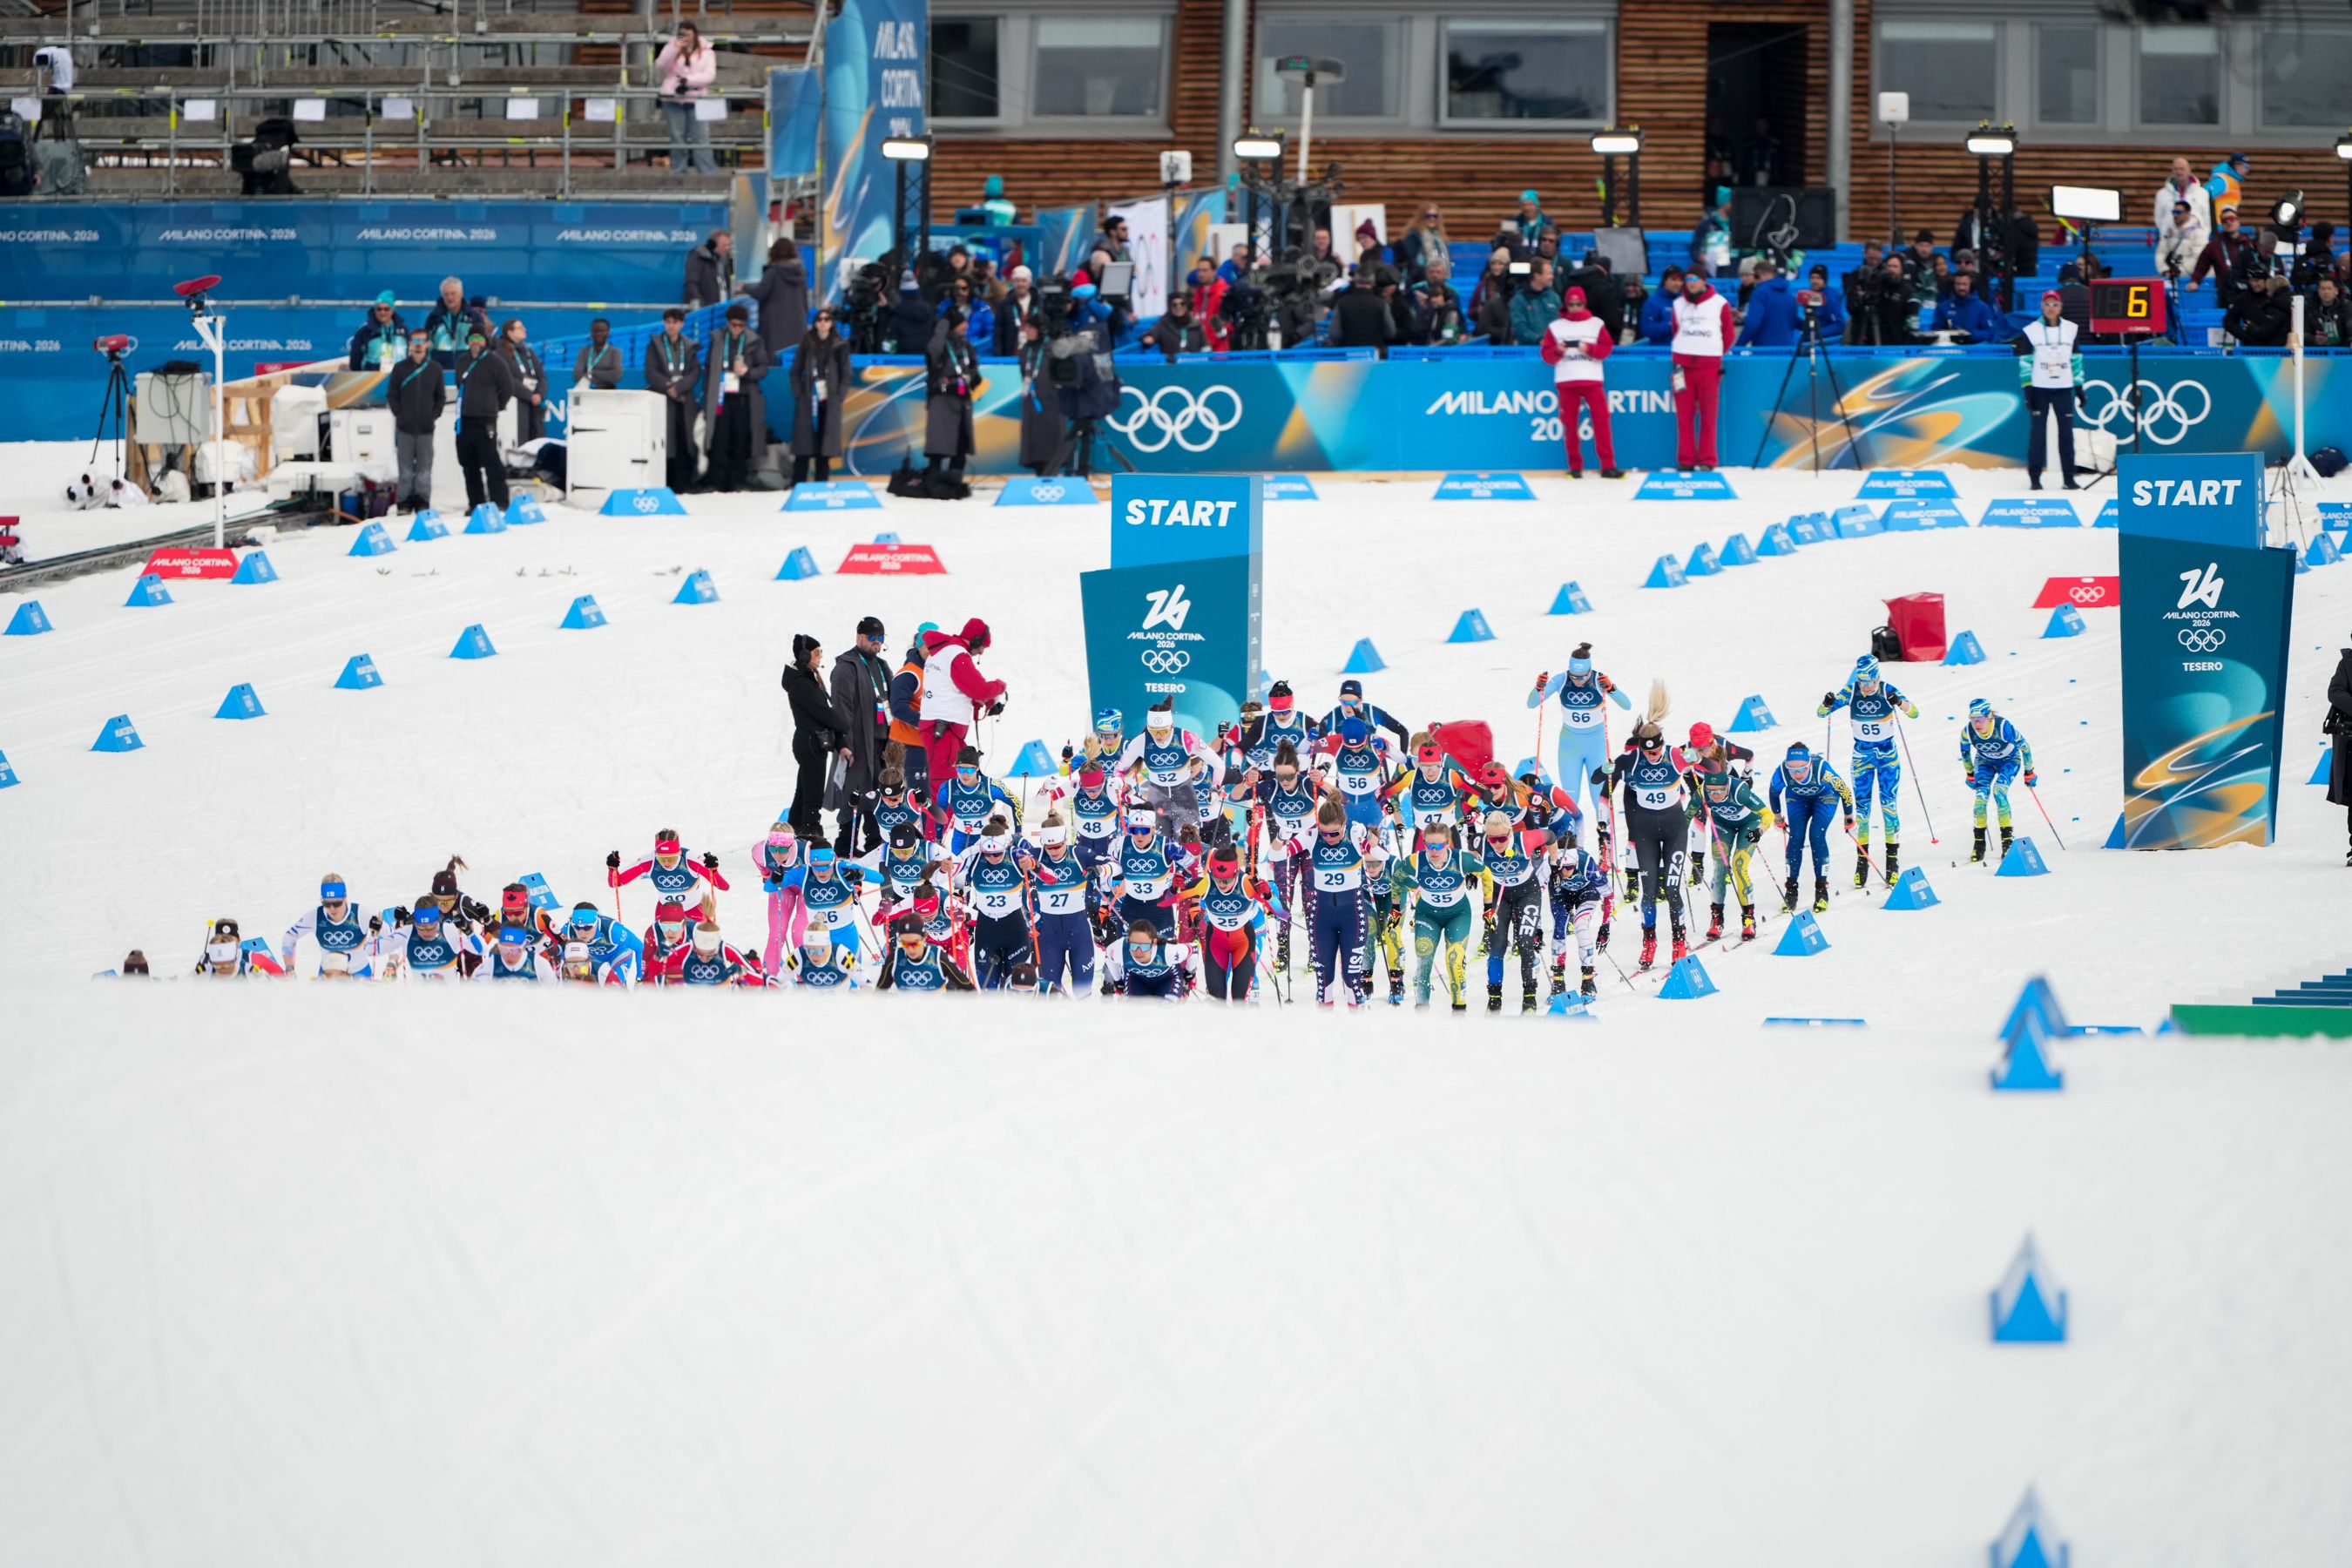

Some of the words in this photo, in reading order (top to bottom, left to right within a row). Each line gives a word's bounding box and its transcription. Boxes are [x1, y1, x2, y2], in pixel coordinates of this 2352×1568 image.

[17, 230, 71, 242] CORTINA
[73, 230, 99, 241] 2026
[159, 229, 213, 241] MILANO
[213, 228, 269, 240] CORTINA
[270, 228, 297, 240] 2026
[356, 228, 411, 240] MILANO
[411, 228, 468, 240] CORTINA
[469, 228, 497, 240] 2026
[557, 229, 612, 241] MILANO
[612, 229, 669, 242] CORTINA
[670, 230, 698, 242] 2026
[2127, 287, 2148, 317] 6
[34, 340, 61, 351] 2026
[227, 339, 284, 351] CORTINA
[286, 339, 313, 351] 2026
[1426, 390, 1558, 415] MILANO
[1531, 417, 1595, 441] 206
[2132, 479, 2242, 506] START
[1125, 499, 1237, 527] START
[152, 558, 193, 567] MILANO
[192, 558, 233, 567] CORTINA
[181, 566, 201, 575] 2026
[1126, 632, 1165, 641] MILANO
[1166, 632, 1206, 641] CORTINA
[1156, 640, 1175, 649] 2026
[2182, 662, 2223, 672] TESERO
[1145, 682, 1186, 693] TESERO
[1571, 712, 1591, 723] 66
[1862, 724, 1881, 736] 65
[1157, 772, 1177, 782] 52
[1348, 777, 1368, 789] 56
[1645, 793, 1666, 804] 49
[963, 820, 983, 829] 54
[1286, 819, 1302, 829] 51
[1424, 814, 1443, 823] 47
[1083, 821, 1102, 833] 48
[1666, 850, 1684, 887] CZE
[1324, 873, 1345, 885] 29
[1132, 882, 1152, 894] 33
[985, 895, 1006, 908] 23
[1050, 893, 1070, 908] 27
[1431, 894, 1452, 903] 35
[1217, 917, 1239, 927] 25
[1518, 904, 1539, 937] CZE
[1348, 945, 1366, 974] USA
